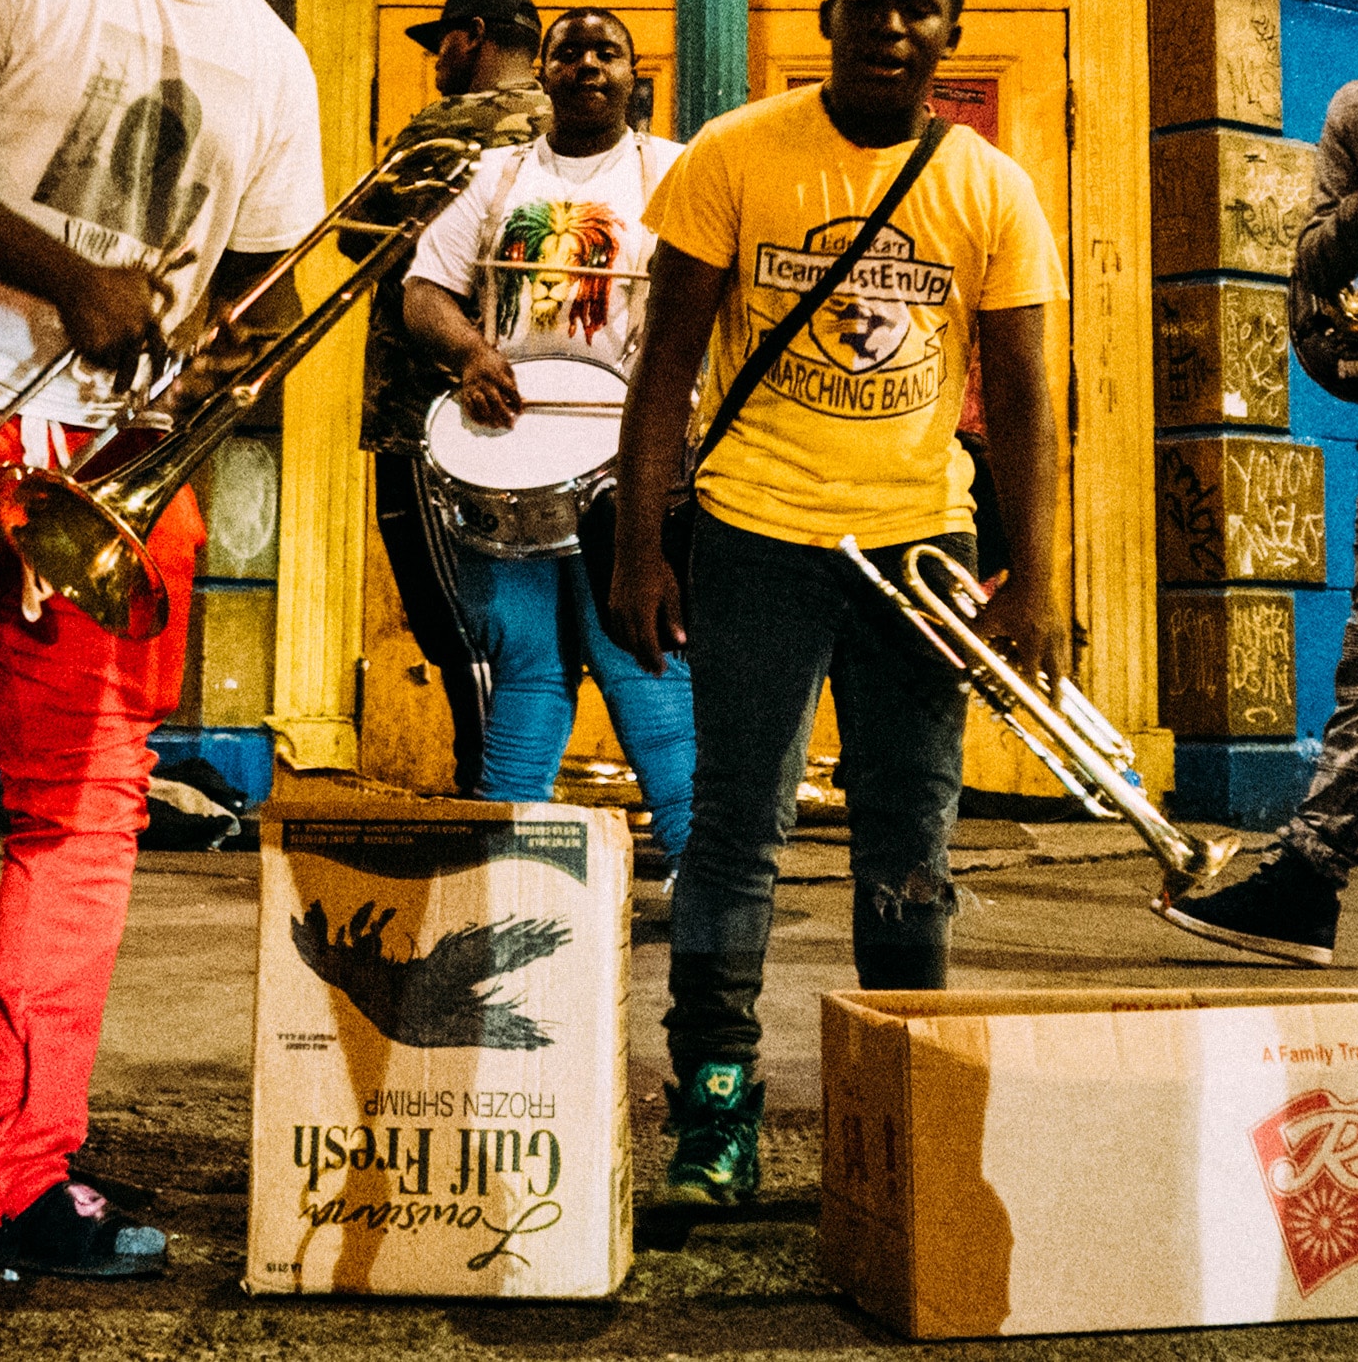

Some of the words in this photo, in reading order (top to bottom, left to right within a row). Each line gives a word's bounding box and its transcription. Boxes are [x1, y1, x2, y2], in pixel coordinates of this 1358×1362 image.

[762, 360, 875, 411] MARCHING
[881, 365, 935, 410] BAND
[1262, 1046, 1275, 1063] A
[1278, 1043, 1334, 1067] Family
[363, 1090, 455, 1118] SHRIMP
[463, 1091, 556, 1119] FROZEN
[292, 1124, 433, 1195] Fresh
[449, 1128, 562, 1198] Gulf
[298, 1199, 562, 1272] Louisiana
